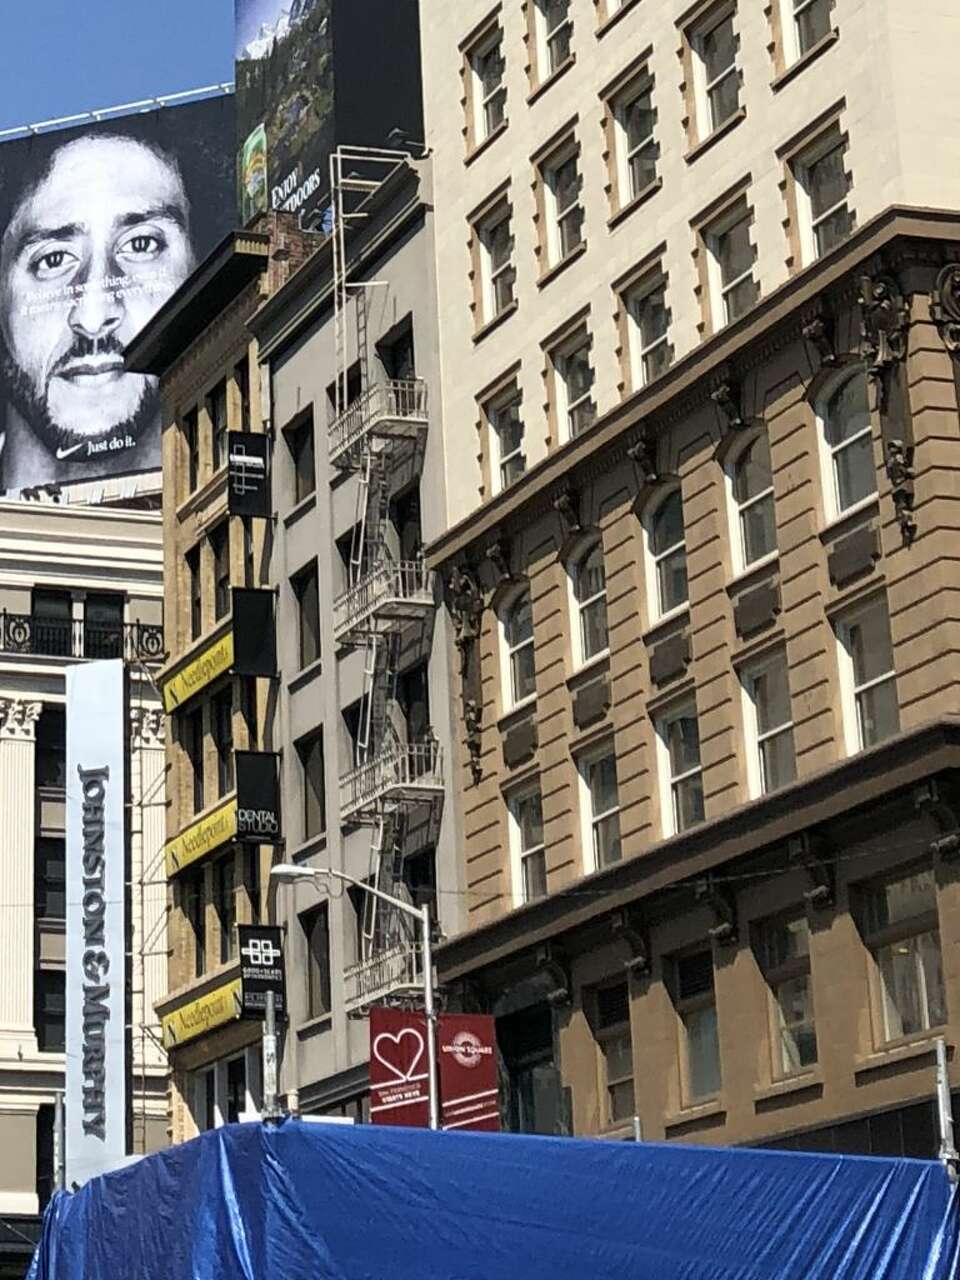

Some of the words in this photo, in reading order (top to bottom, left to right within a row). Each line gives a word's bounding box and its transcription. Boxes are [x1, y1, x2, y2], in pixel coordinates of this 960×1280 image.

[271, 167, 298, 210] ENJOY
[280, 168, 321, 212] TDOORS
[87, 440, 108, 456] Just
[109, 436, 124, 450] do
[125, 435, 136, 447] it.
[238, 808, 275, 823] DENTAL
[238, 820, 279, 833] STUDIO
[77, 763, 110, 947] JOHNSTON
[82, 949, 110, 985] &
[82, 982, 110, 1143] MURPHY
